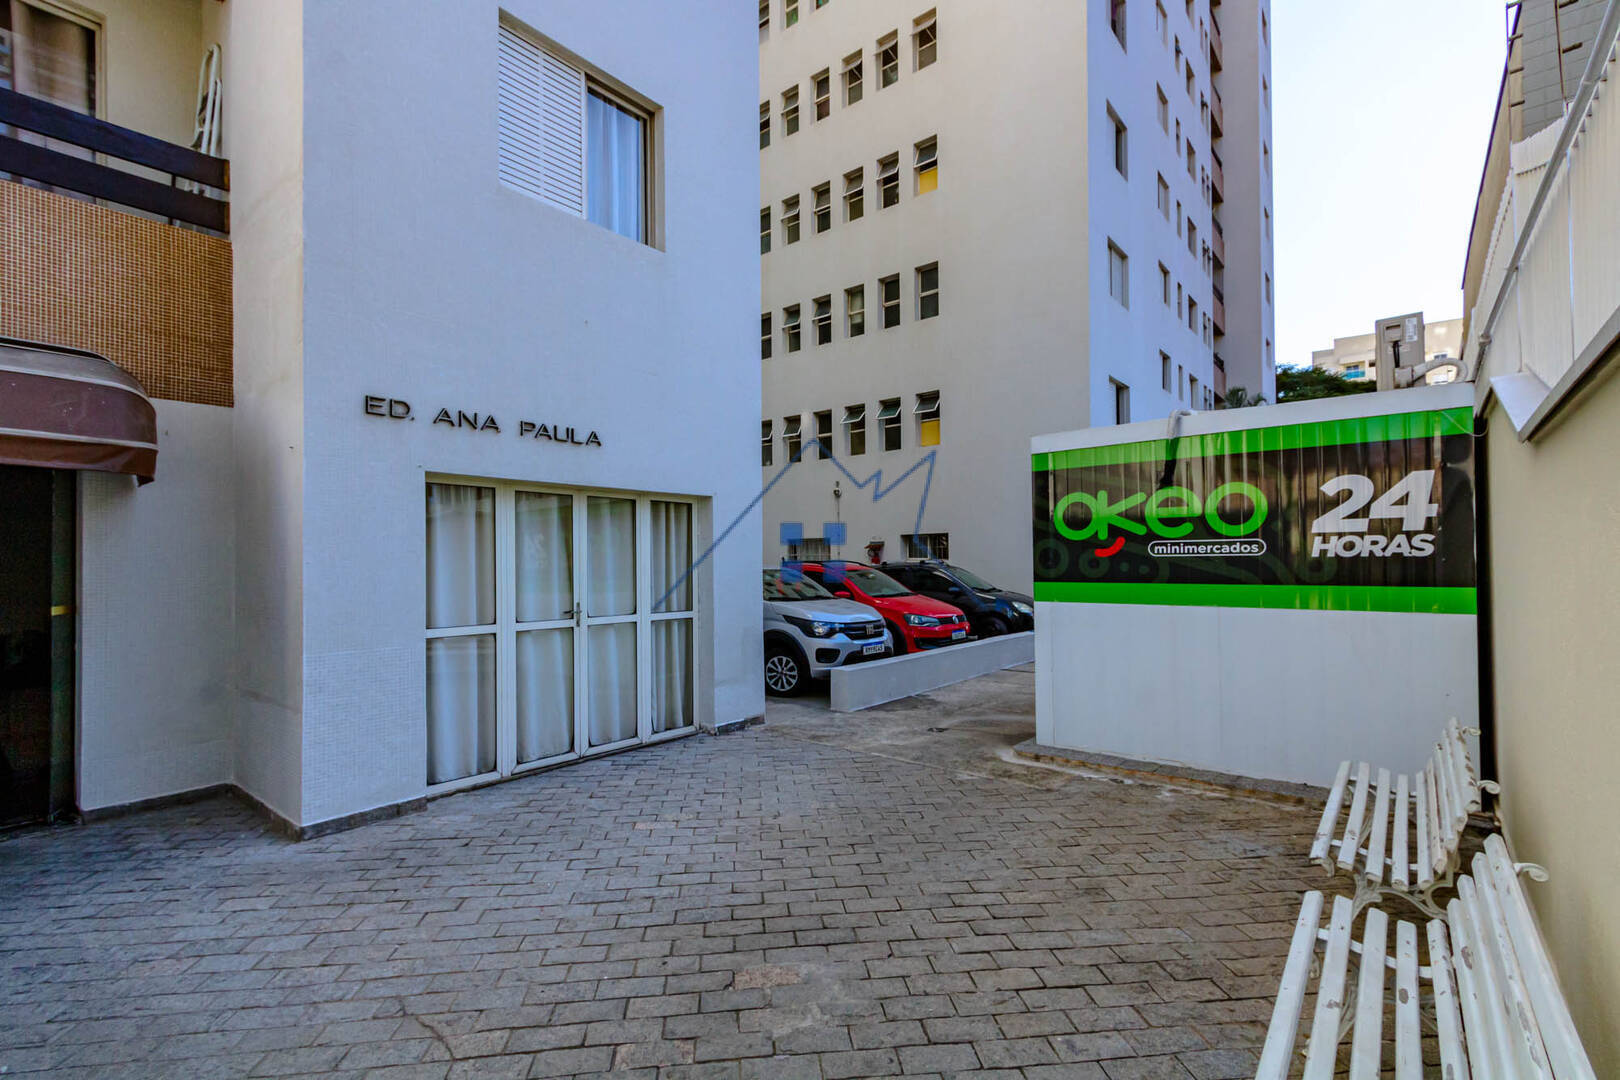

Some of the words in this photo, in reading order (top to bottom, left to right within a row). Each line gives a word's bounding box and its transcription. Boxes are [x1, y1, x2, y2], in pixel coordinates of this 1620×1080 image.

[365, 394, 416, 422] ED.
[433, 407, 502, 434] ANA
[519, 420, 602, 447] PAULA
[1312, 469, 1439, 534] 24
[1153, 541, 1260, 555] minimercados
[1311, 533, 1436, 558] HORAS
